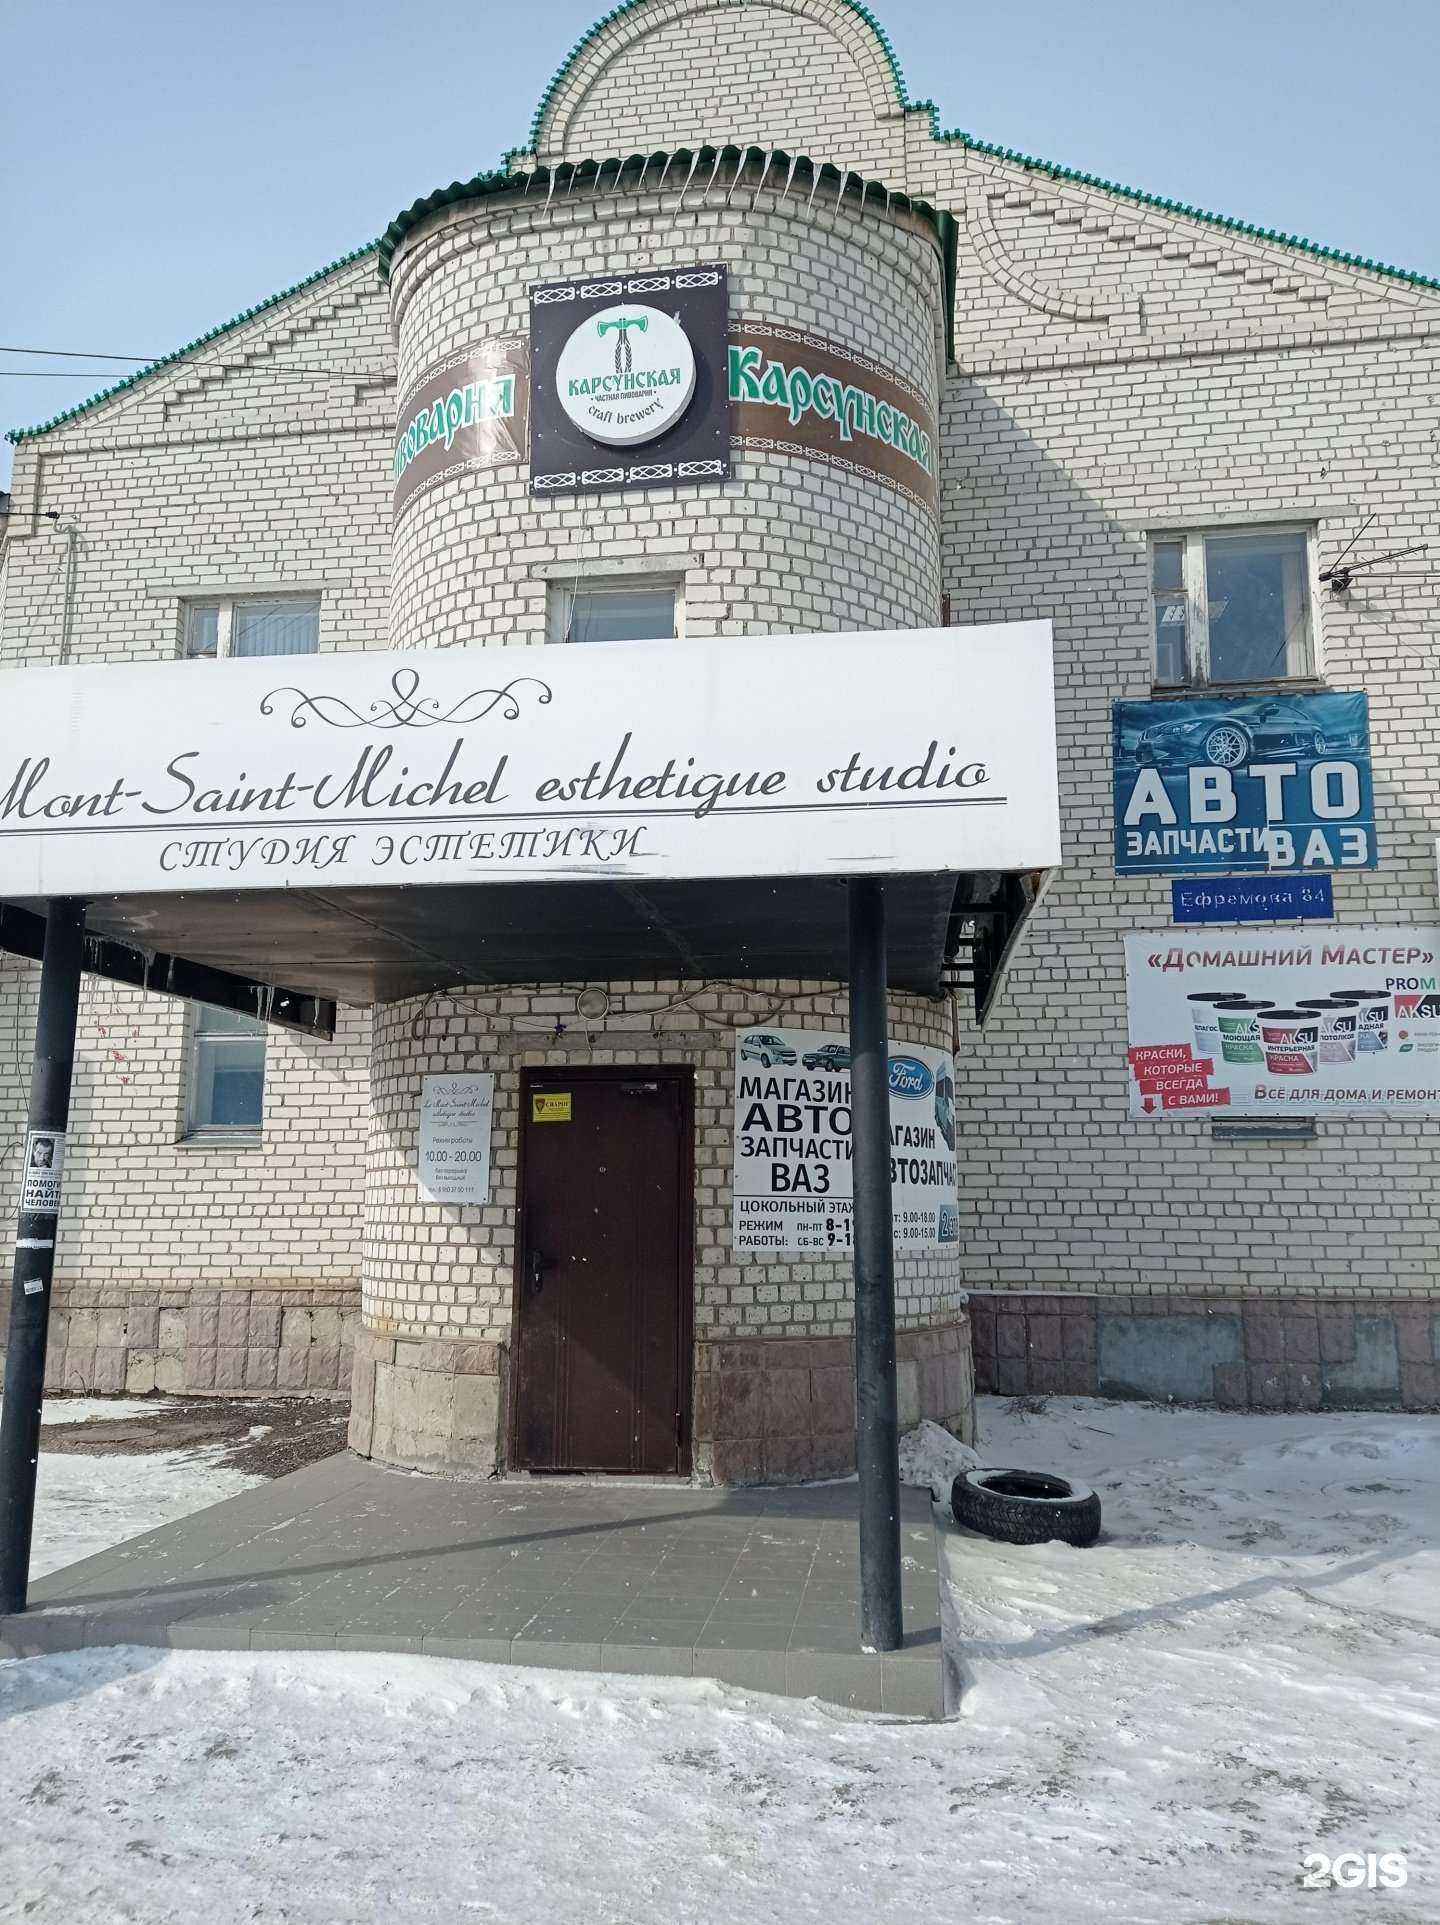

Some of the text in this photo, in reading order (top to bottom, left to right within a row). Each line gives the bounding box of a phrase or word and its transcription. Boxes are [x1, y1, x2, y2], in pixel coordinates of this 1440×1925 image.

[568, 368, 681, 396] КАРСУНСКАЯ
[595, 392, 620, 402] ЧАСТНАЯ
[588, 397, 664, 424] craft brewery
[816, 740, 990, 793] studio
[1123, 761, 1361, 826] АВТО
[159, 827, 647, 871] СТУДИЯ ЭСТЕТИКИ
[1126, 827, 1368, 867] ЗАПЧАСТИ ВАЗ
[1181, 891, 1293, 909] Ефремова
[1235, 1021, 1261, 1035] AKS
[889, 1062, 923, 1091] Ford
[1144, 1063, 1203, 1075] КОТОРЫЕ
[1156, 1079, 1203, 1090] ВСЕГДА
[1180, 1094, 1218, 1105] ВАМИ!
[1289, 1089, 1320, 1100] ДЛЯ
[1324, 1089, 1367, 1100] ДОМА
[1372, 1089, 1381, 1099] И
[741, 1103, 852, 1135] АВТО
[890, 1125, 935, 1149] ГАЗИН
[454, 1150, 481, 1161] 20.00
[771, 1163, 830, 1193] ВАЗ
[740, 1199, 825, 1214] ЦОКОЛЬНЫЙ
[739, 1220, 783, 1230] РЕЖИМ
[826, 1218, 854, 1231] 8-1
[739, 1236, 788, 1246] РАБОТЫ:
[828, 1233, 855, 1246] 9-1
